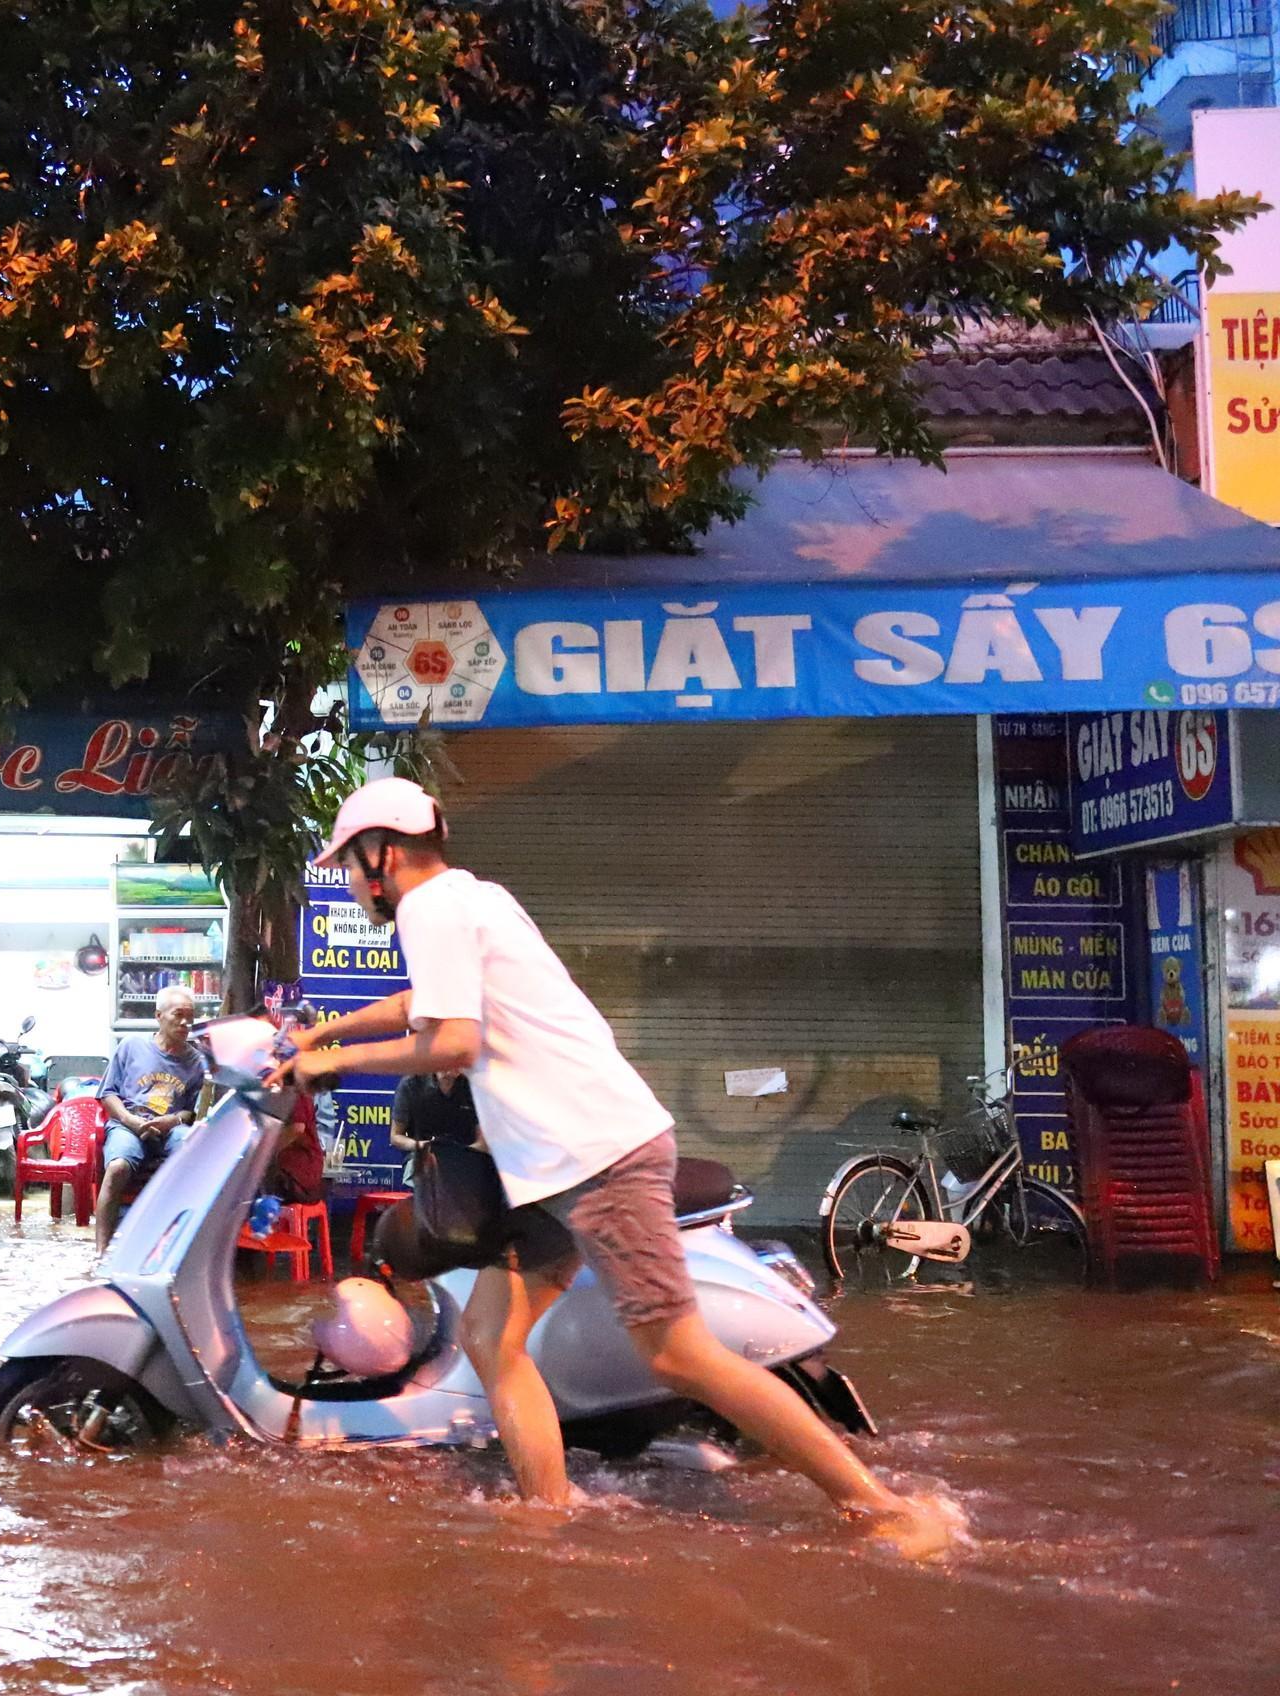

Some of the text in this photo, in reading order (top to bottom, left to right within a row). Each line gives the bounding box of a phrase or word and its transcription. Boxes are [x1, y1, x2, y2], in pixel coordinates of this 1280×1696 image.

[514, 601, 812, 707] GIẶT
[853, 583, 1121, 686] SẤY
[414, 651, 447, 677] 6S
[1181, 683, 1228, 706] 096
[1180, 711, 1215, 781] 6S
[312, 944, 399, 973] CÁC LOẠI
[347, 1105, 391, 1125] SINH
